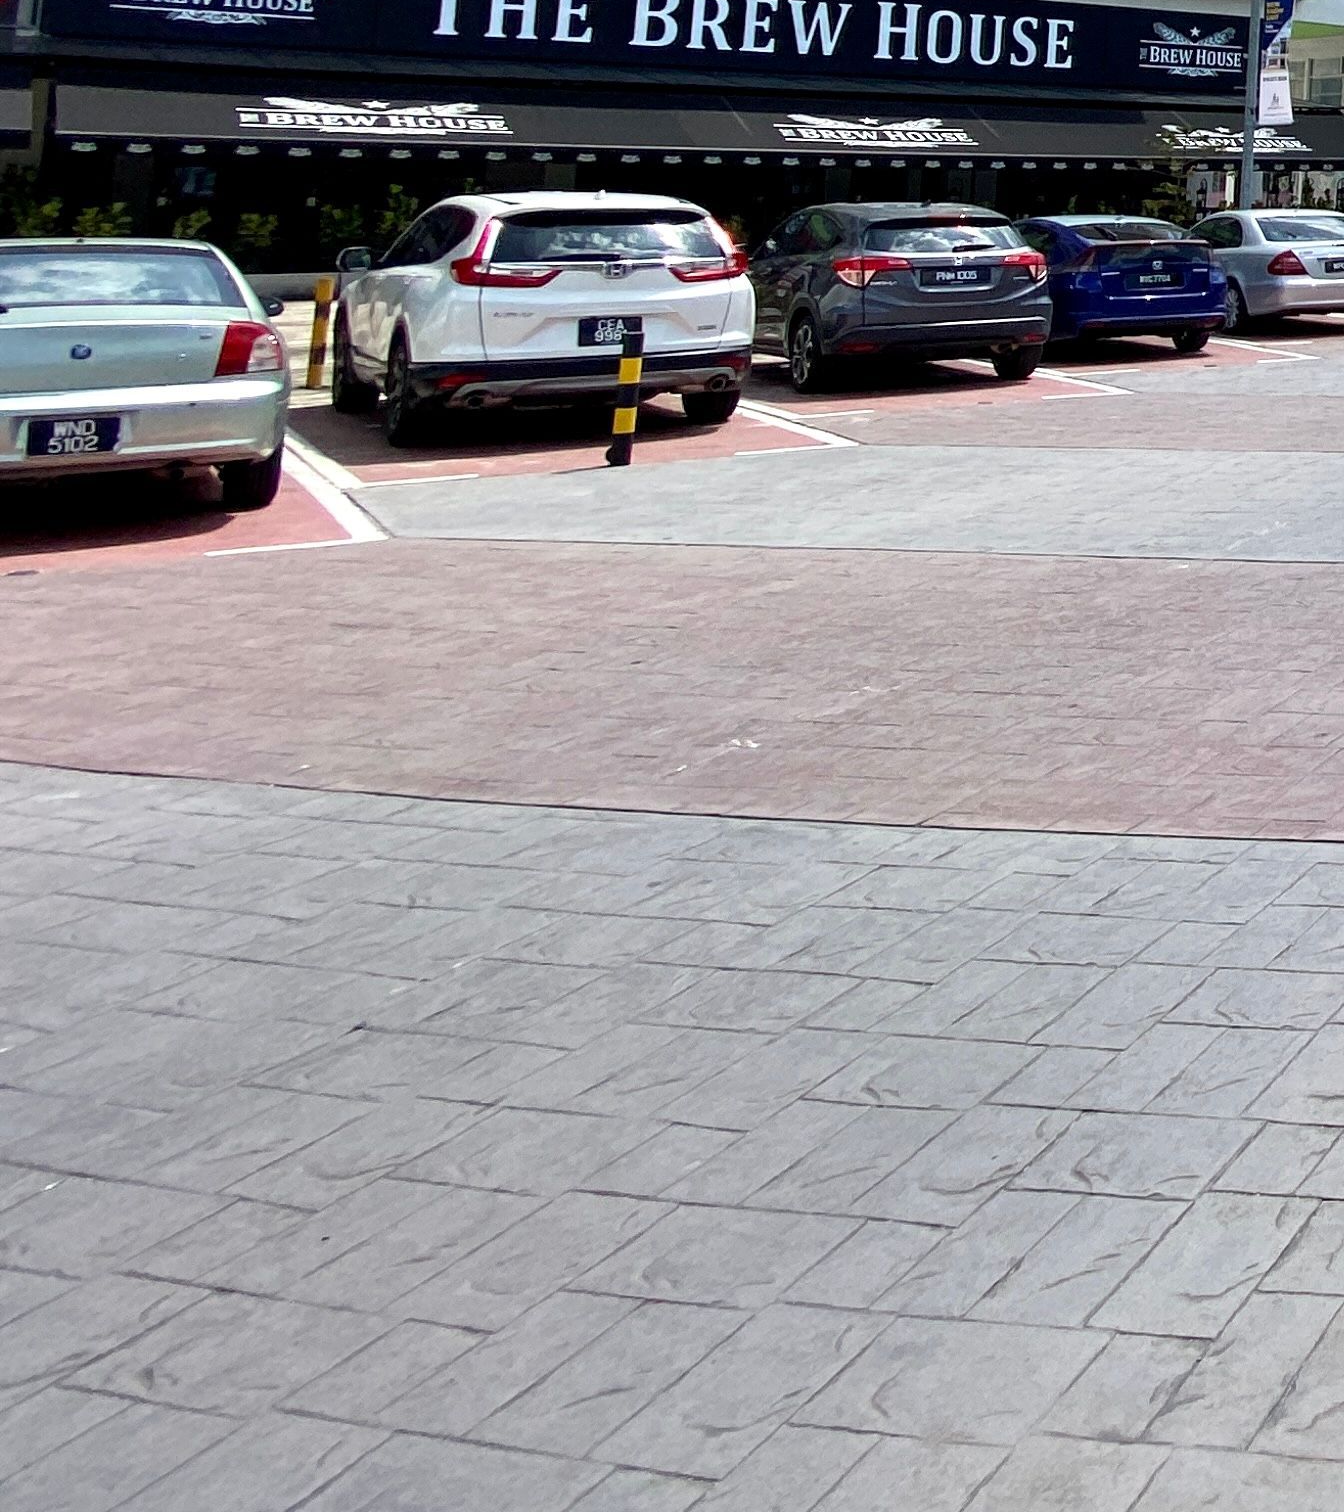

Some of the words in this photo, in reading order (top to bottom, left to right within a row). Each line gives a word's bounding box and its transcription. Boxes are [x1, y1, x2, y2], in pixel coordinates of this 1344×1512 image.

[873, 1, 1075, 69] HOUSE
[1149, 45, 1194, 65] BREW
[1195, 49, 1242, 68] HOUSE
[265, 112, 380, 127] BREW
[389, 115, 510, 131] HOUSE
[797, 128, 879, 141] BREW
[883, 129, 974, 143] HOUSE
[53, 419, 97, 438] WND
[47, 435, 100, 454] 5102
